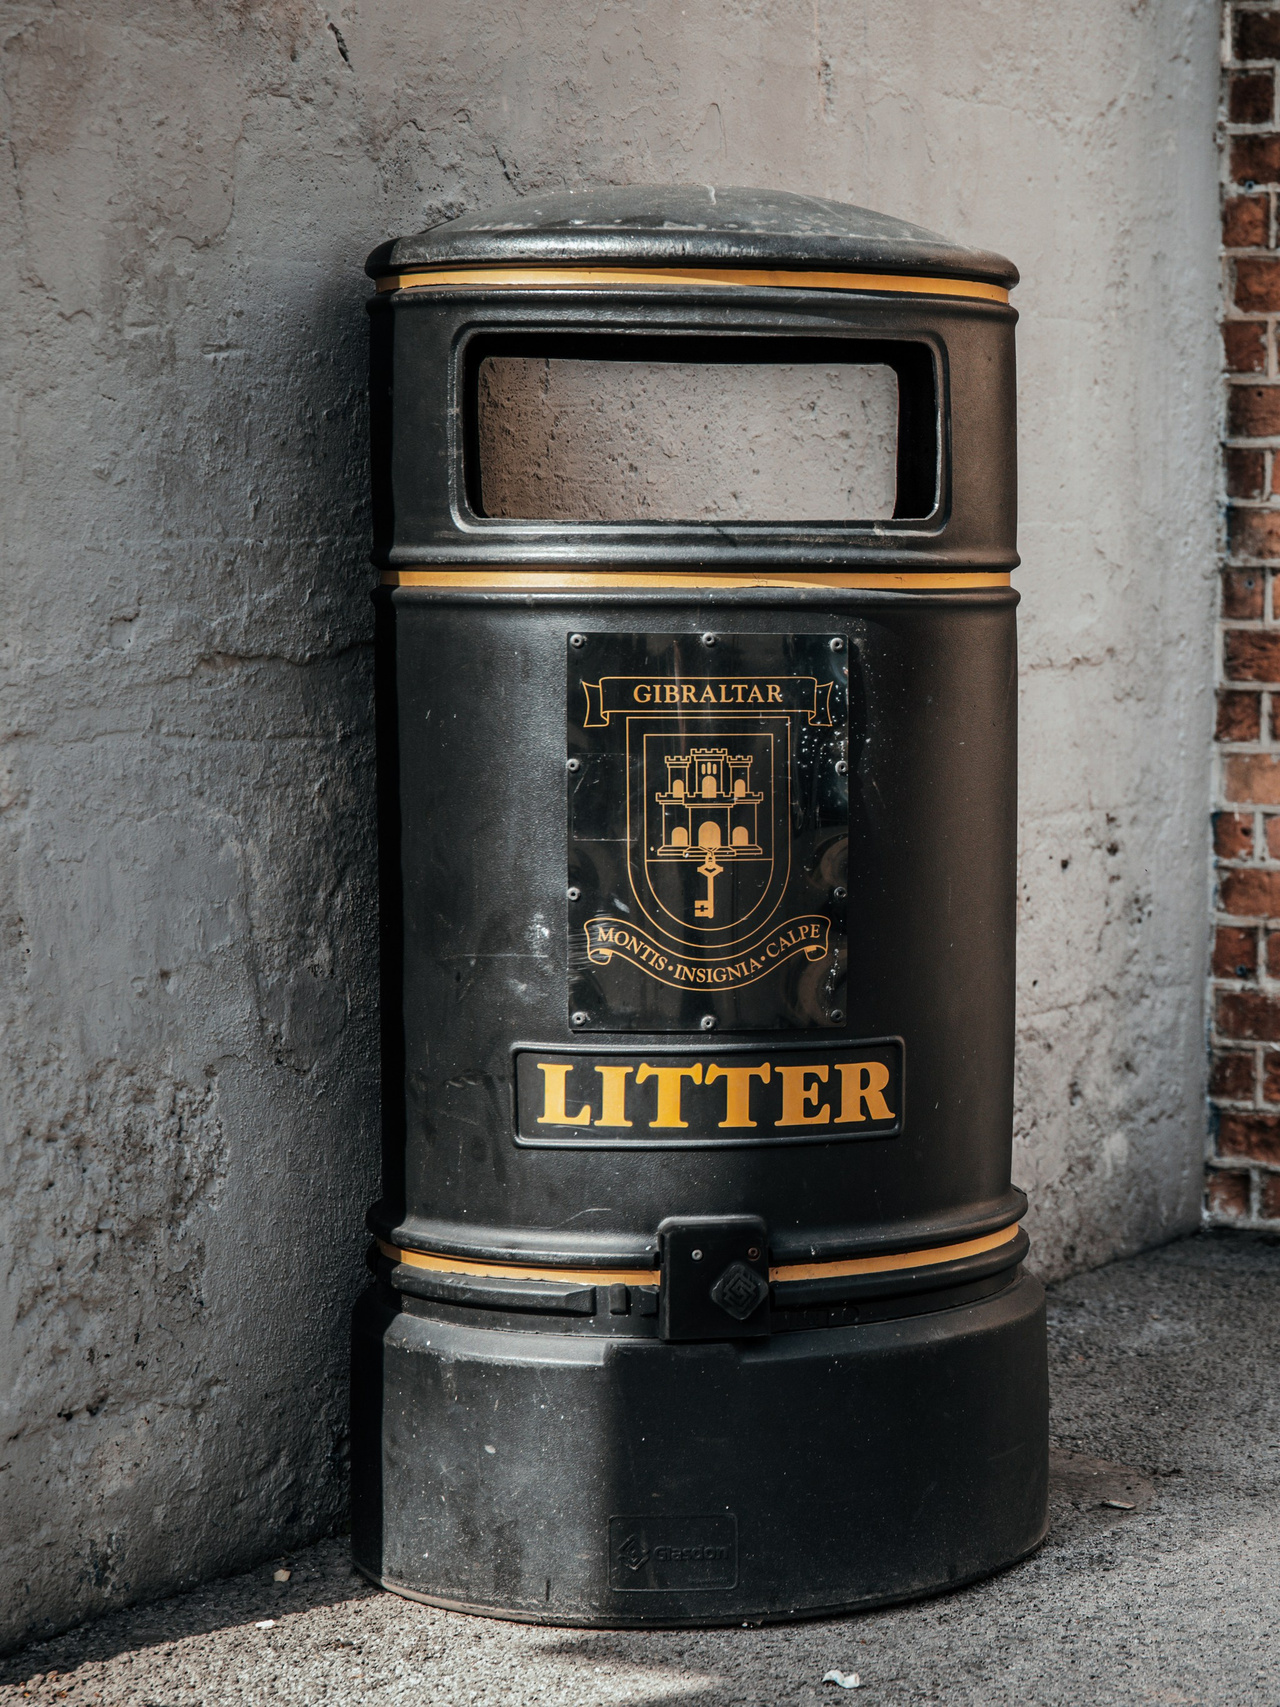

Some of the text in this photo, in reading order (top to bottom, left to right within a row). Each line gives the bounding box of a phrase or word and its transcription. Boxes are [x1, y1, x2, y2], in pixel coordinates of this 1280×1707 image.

[633, 684, 783, 703] GIBRALTAR
[597, 923, 821, 983] MONTIS INSIGNIA CALPE
[536, 1061, 896, 1128] LITTER
[653, 1545, 728, 1561] Glasdon
